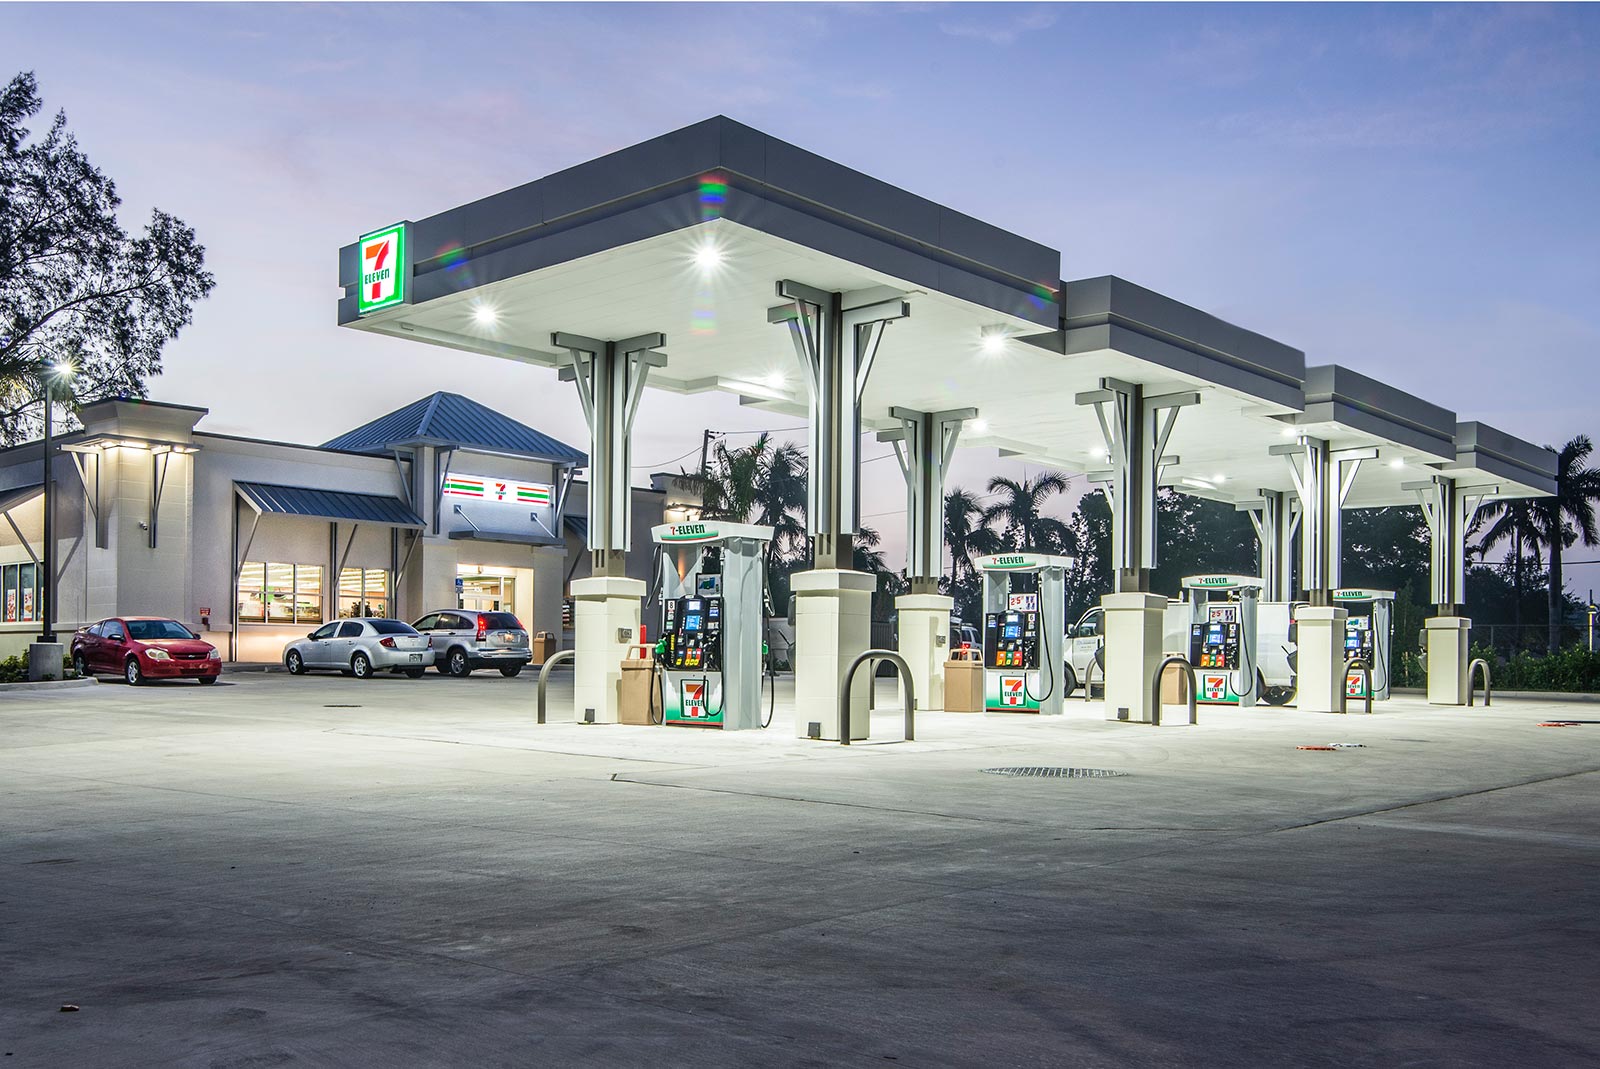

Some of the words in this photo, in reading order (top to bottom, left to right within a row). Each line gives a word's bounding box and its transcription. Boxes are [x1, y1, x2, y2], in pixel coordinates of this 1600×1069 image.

[365, 240, 389, 300] 7
[495, 483, 506, 500] 7
[1005, 680, 1022, 704] 7
[1207, 677, 1223, 698] 7
[1346, 676, 1360, 694] 7
[685, 684, 704, 716] 7
